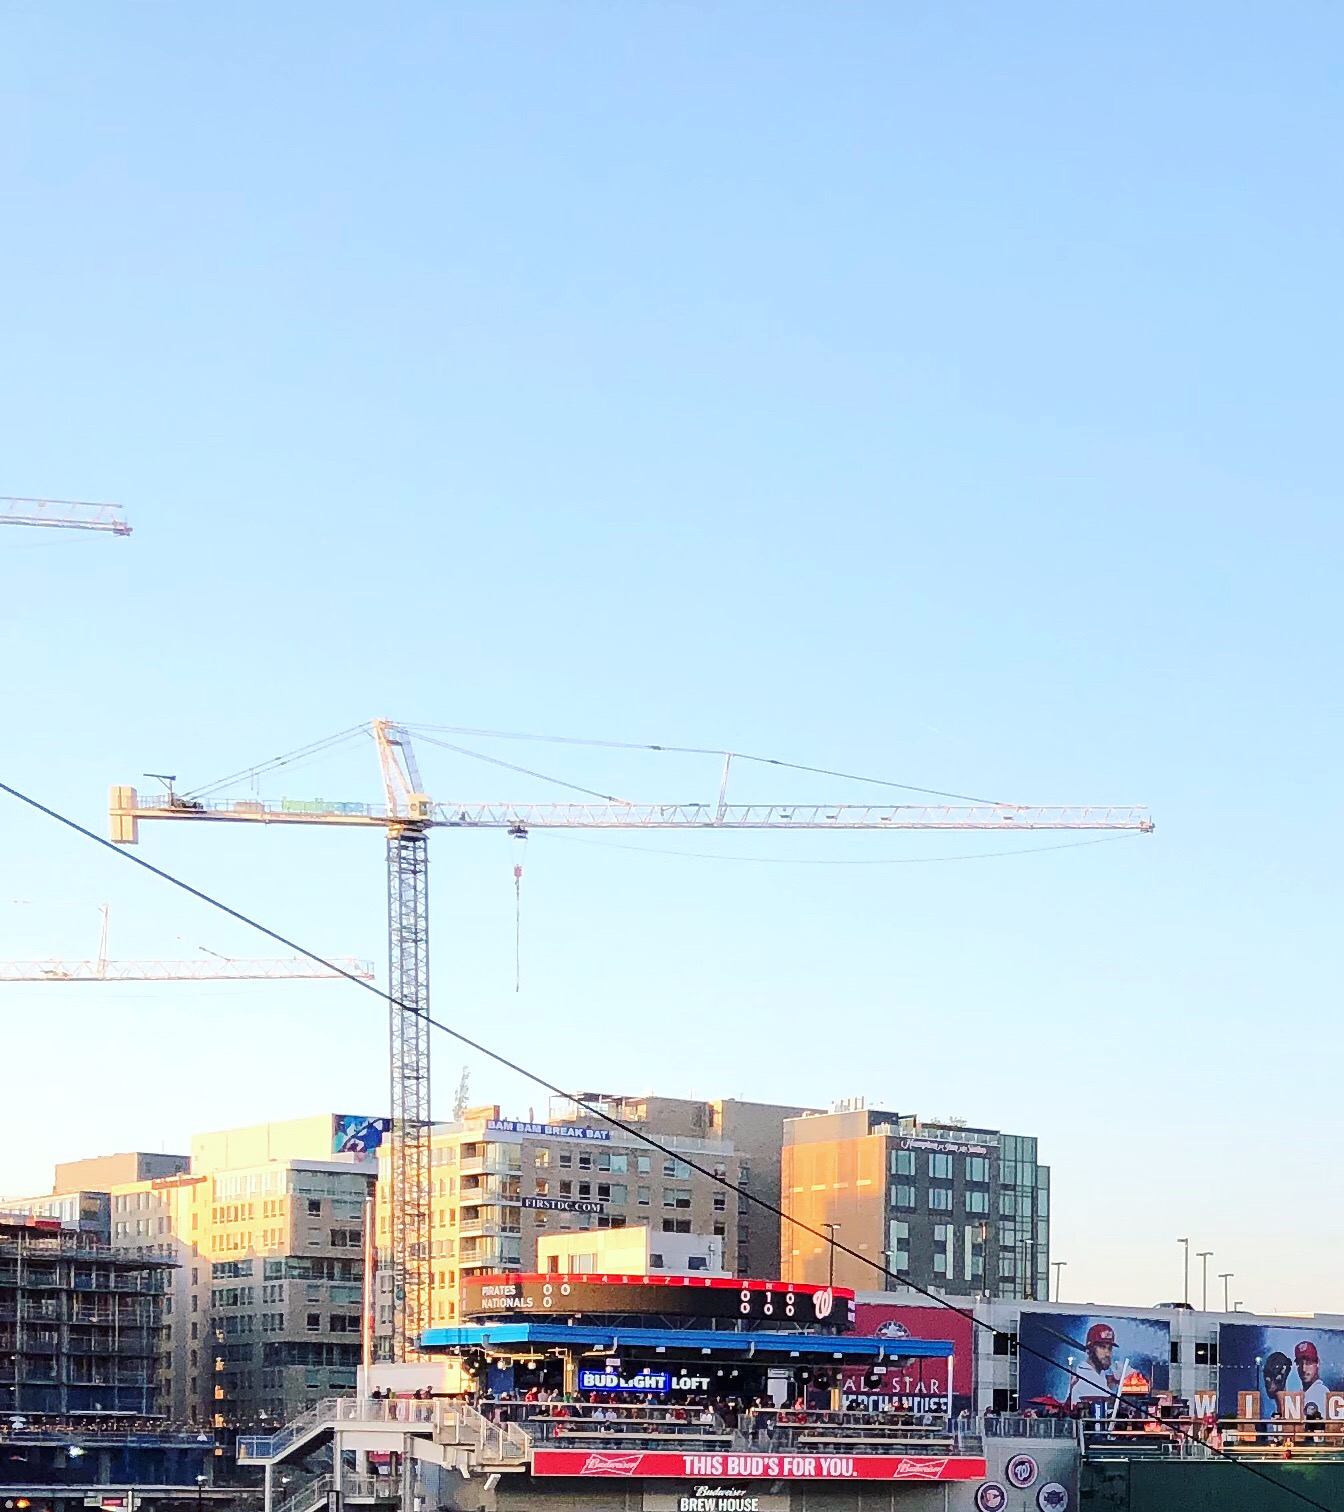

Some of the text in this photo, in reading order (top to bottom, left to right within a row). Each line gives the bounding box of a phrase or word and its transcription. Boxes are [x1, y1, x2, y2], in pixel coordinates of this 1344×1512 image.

[488, 1120, 513, 1131] BAM
[545, 1125, 583, 1137] BREAK
[586, 1130, 609, 1139] BAT
[525, 1198, 600, 1212] FIRSTDC.COM
[482, 1284, 516, 1296] PIRATES
[482, 1297, 533, 1309] NATIONALS
[583, 1374, 619, 1387] BUD
[671, 1377, 710, 1390] LOFT
[683, 1456, 858, 1477] THIS BUD'S FOR YOU.
[680, 1498, 759, 1512] BREW HOUSE
